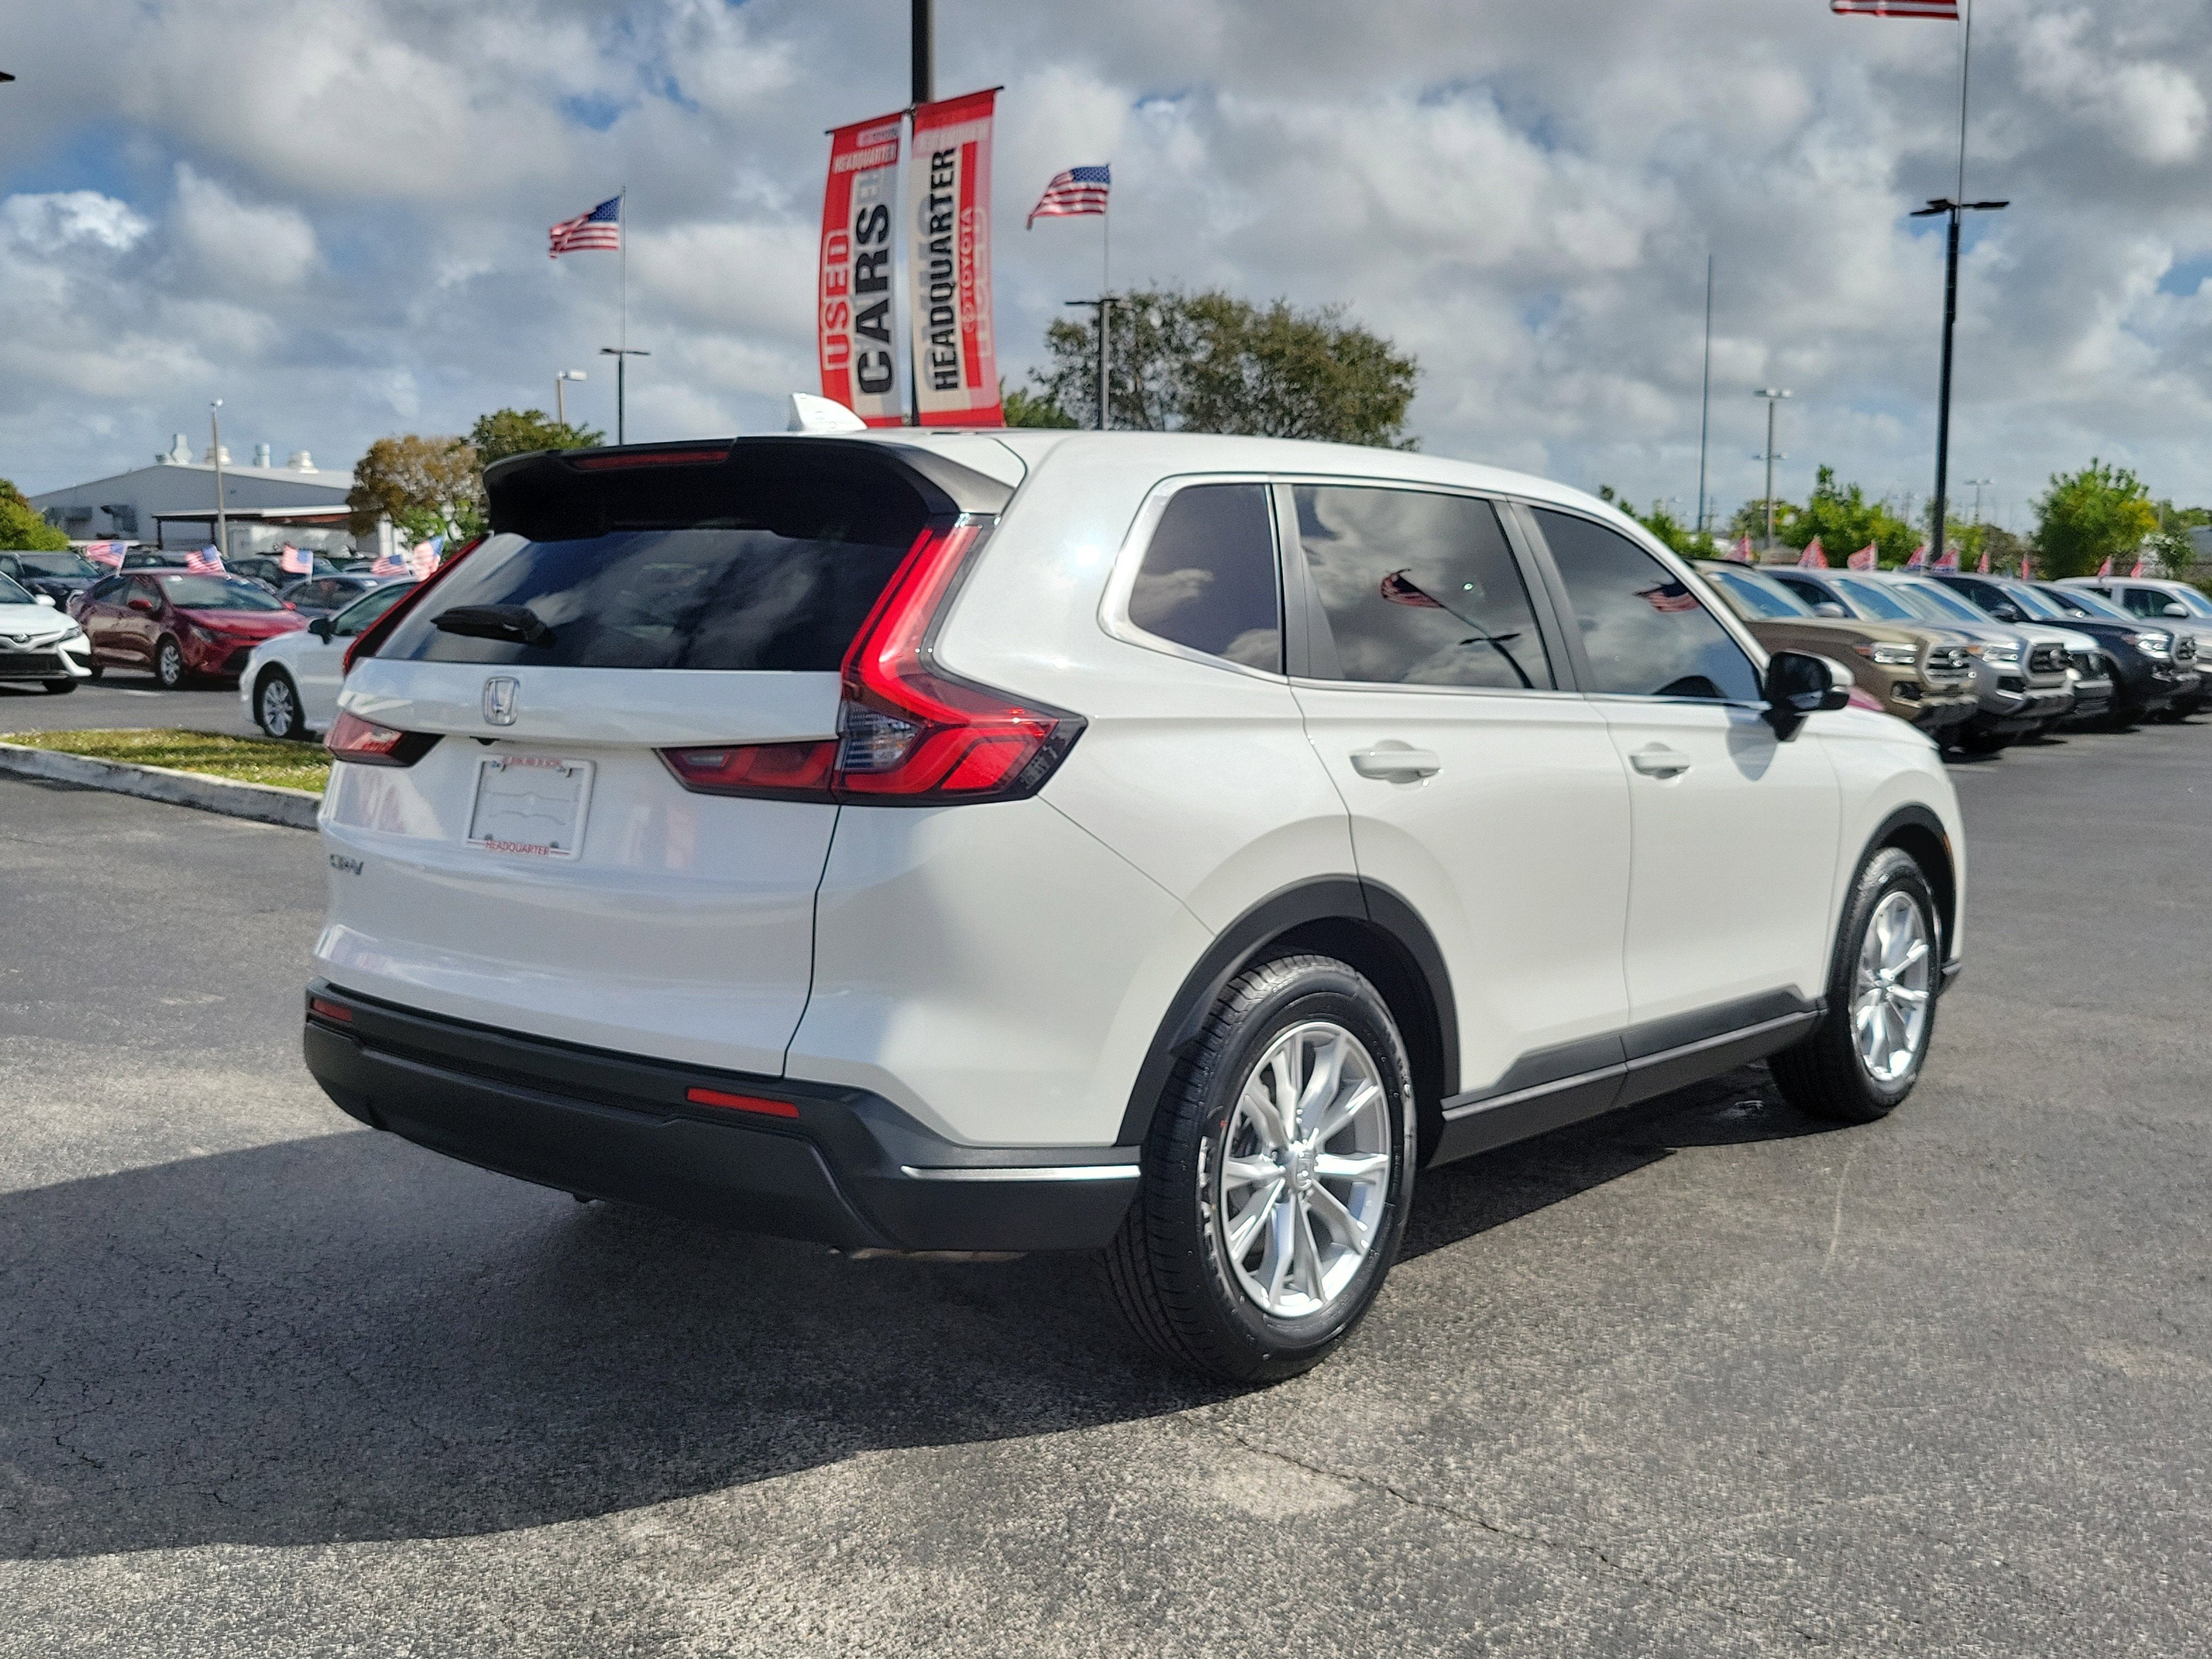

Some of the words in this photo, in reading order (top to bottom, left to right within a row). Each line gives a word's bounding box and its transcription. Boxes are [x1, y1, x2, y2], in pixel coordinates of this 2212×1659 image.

[825, 234, 849, 365] USED
[856, 204, 892, 394] CARS
[930, 146, 959, 390] HEADQUARTER
[960, 207, 974, 298] TOYOTA
